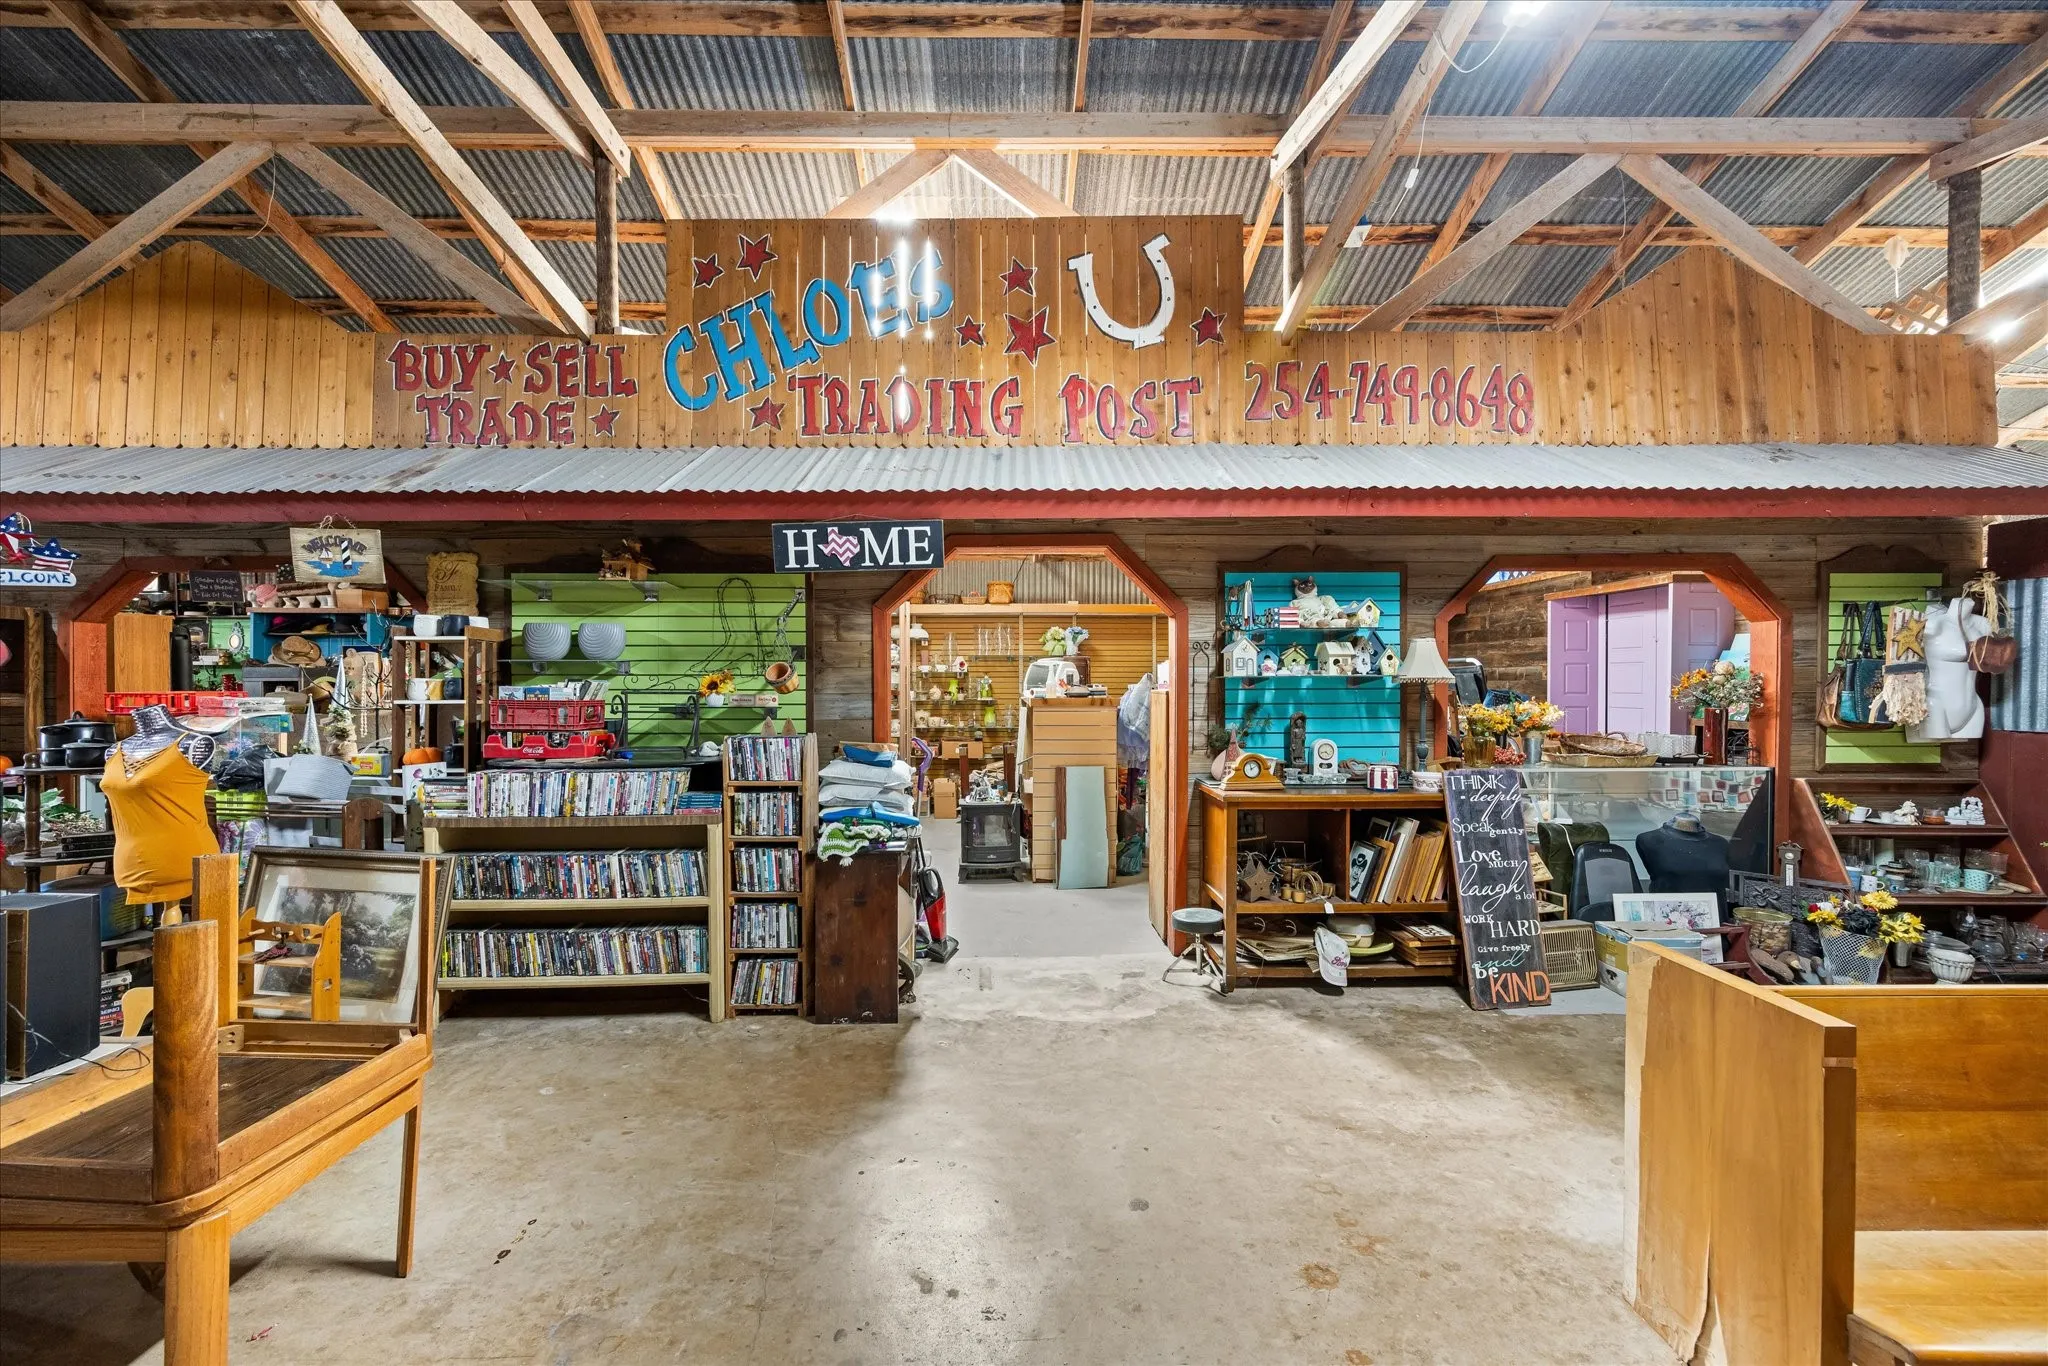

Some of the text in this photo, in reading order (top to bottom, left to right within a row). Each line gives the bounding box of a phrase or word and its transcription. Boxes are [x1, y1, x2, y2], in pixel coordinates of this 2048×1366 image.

[663, 247, 954, 412] CHLOES
[388, 339, 638, 398] BUY SELL
[788, 373, 1200, 443] TRADING POST
[1244, 360, 1535, 436] 254-749-8648
[415, 395, 576, 445] TRADE
[1446, 774, 1507, 790] THINK
[1470, 781, 1521, 821] deeply
[1452, 817, 1525, 837] Speak gently
[1456, 840, 1501, 864] Love
[1489, 859, 1519, 868] MUCH
[1460, 860, 1528, 913] laugh
[1463, 914, 1541, 938] WORK HARD
[1472, 950, 1526, 969] and
[1501, 944, 1532, 953] freely
[1474, 963, 1499, 979] be
[1489, 970, 1551, 1004] KIND
